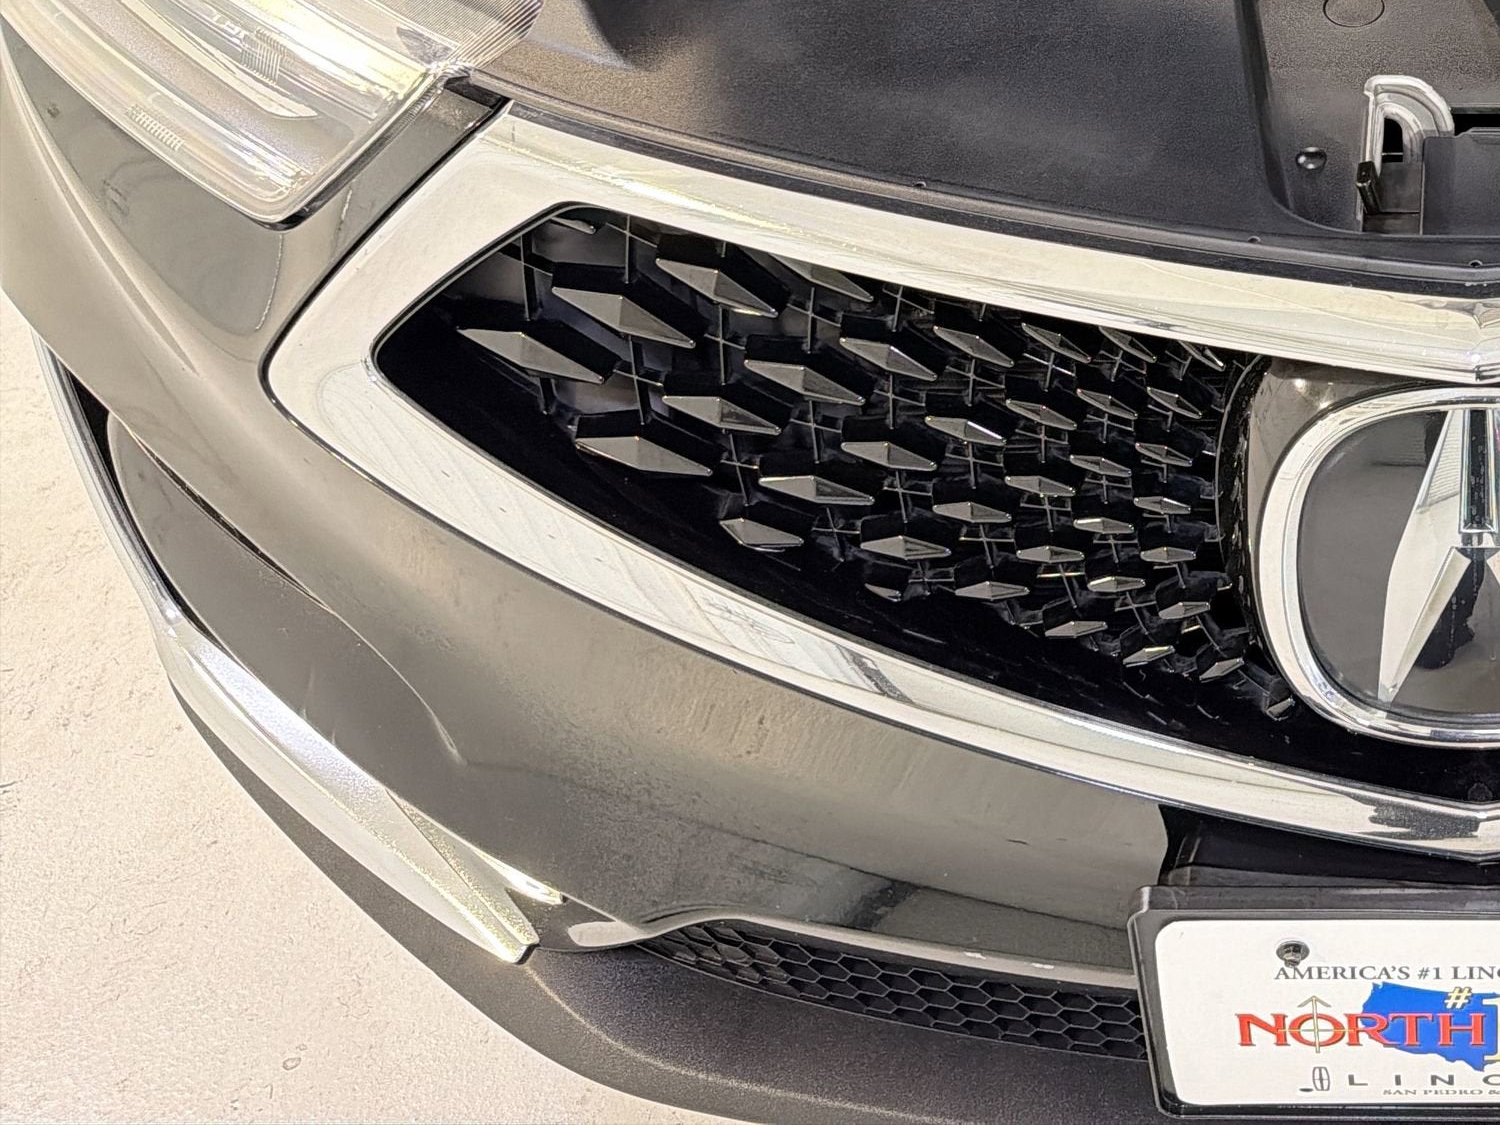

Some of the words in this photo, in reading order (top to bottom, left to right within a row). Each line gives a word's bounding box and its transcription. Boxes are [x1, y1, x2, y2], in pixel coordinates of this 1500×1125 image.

[1273, 965, 1411, 981] AMERICA'S
[1417, 966, 1443, 980] #1
[1235, 1012, 1487, 1048] NORTH
[1383, 1088, 1417, 1096] SAN
[1423, 1088, 1483, 1096] PEDRO
[1488, 1088, 1500, 1096] &
